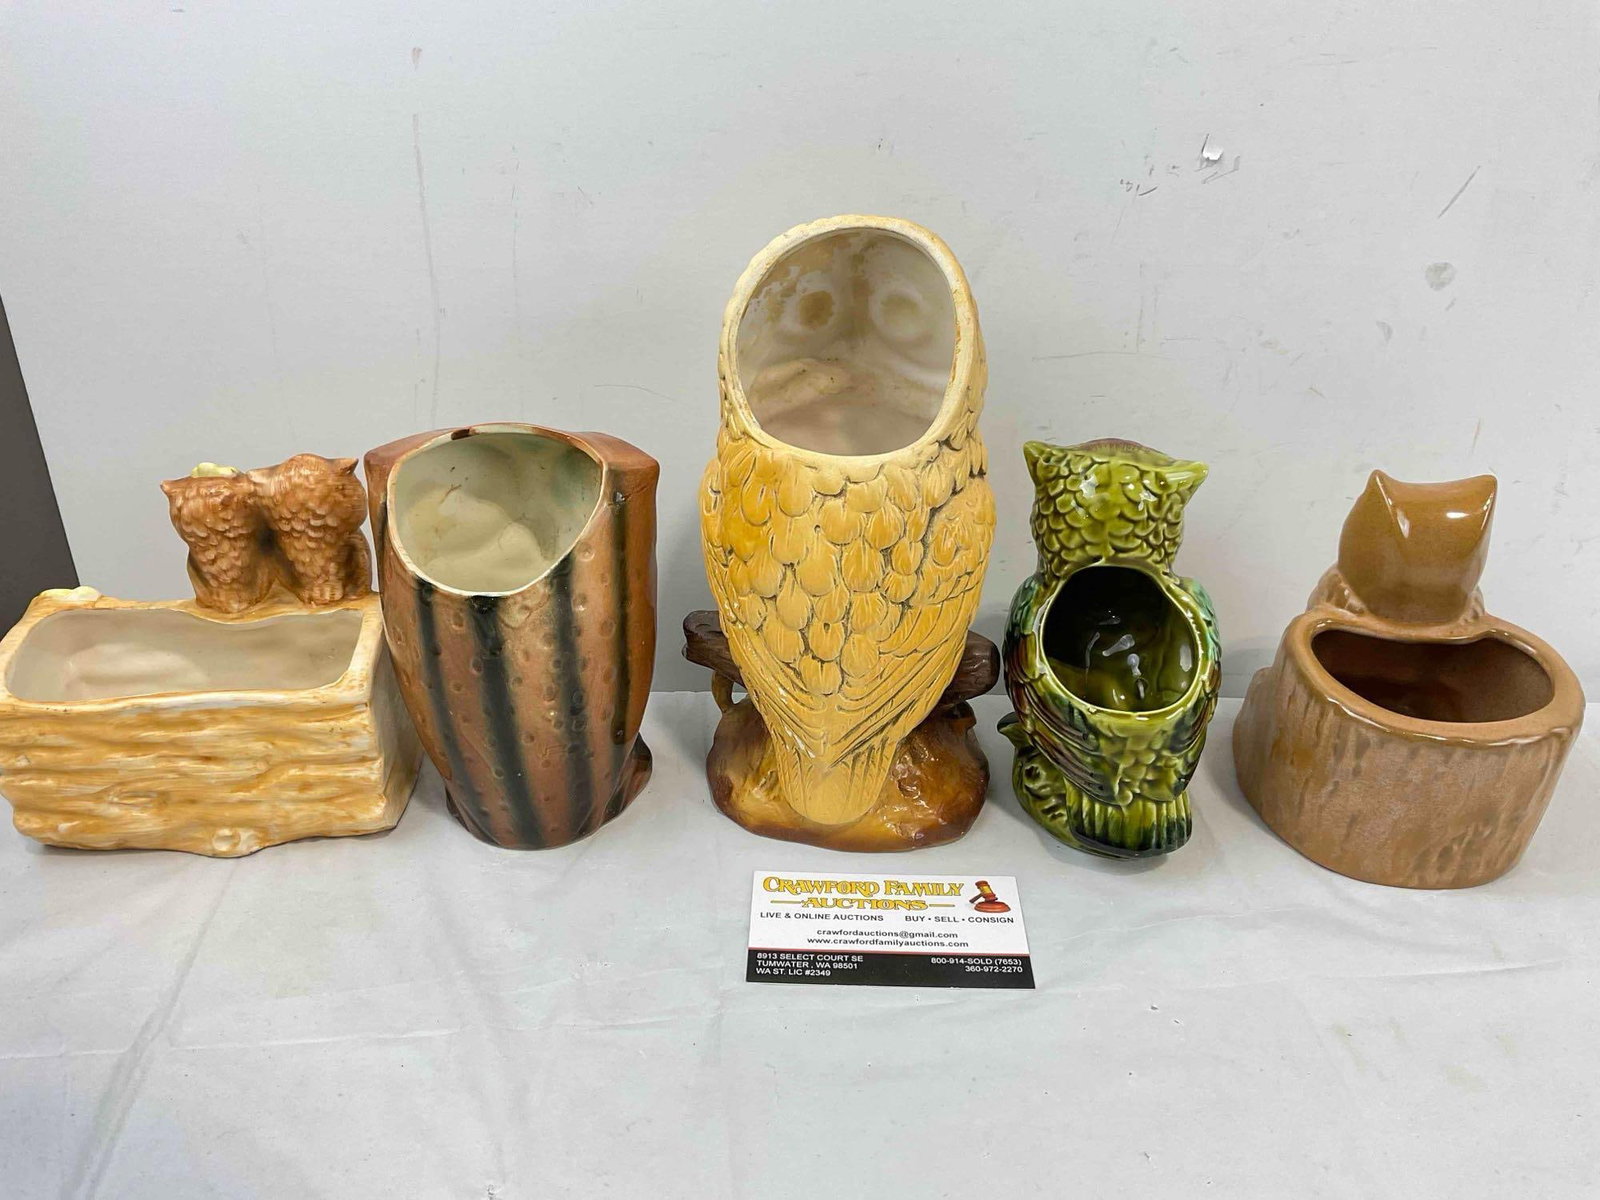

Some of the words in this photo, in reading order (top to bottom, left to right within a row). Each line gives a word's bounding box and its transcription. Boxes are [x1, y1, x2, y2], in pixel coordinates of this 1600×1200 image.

[763, 876, 880, 897] CRAWFORD
[884, 880, 964, 897] FAMILY
[801, 897, 928, 911] AUCTIONS
[816, 929, 958, 939] crawfordauctions@gmail.com
[807, 937, 969, 948] www.crawfordfamilyauctions.com
[757, 952, 779, 960] 8913
[780, 953, 815, 961] SELECT
[816, 954, 849, 962] COURT
[930, 957, 993, 965] 800-914-SOLD
[994, 958, 1022, 966] (7653)
[757, 960, 809, 968] TUMWATER
[815, 961, 831, 969] WA
[832, 962, 858, 970] 98501
[965, 965, 1023, 973] 360-972-2270
[755, 967, 771, 975] WA
[788, 968, 803, 976] LIC
[805, 969, 831, 977] #2349
